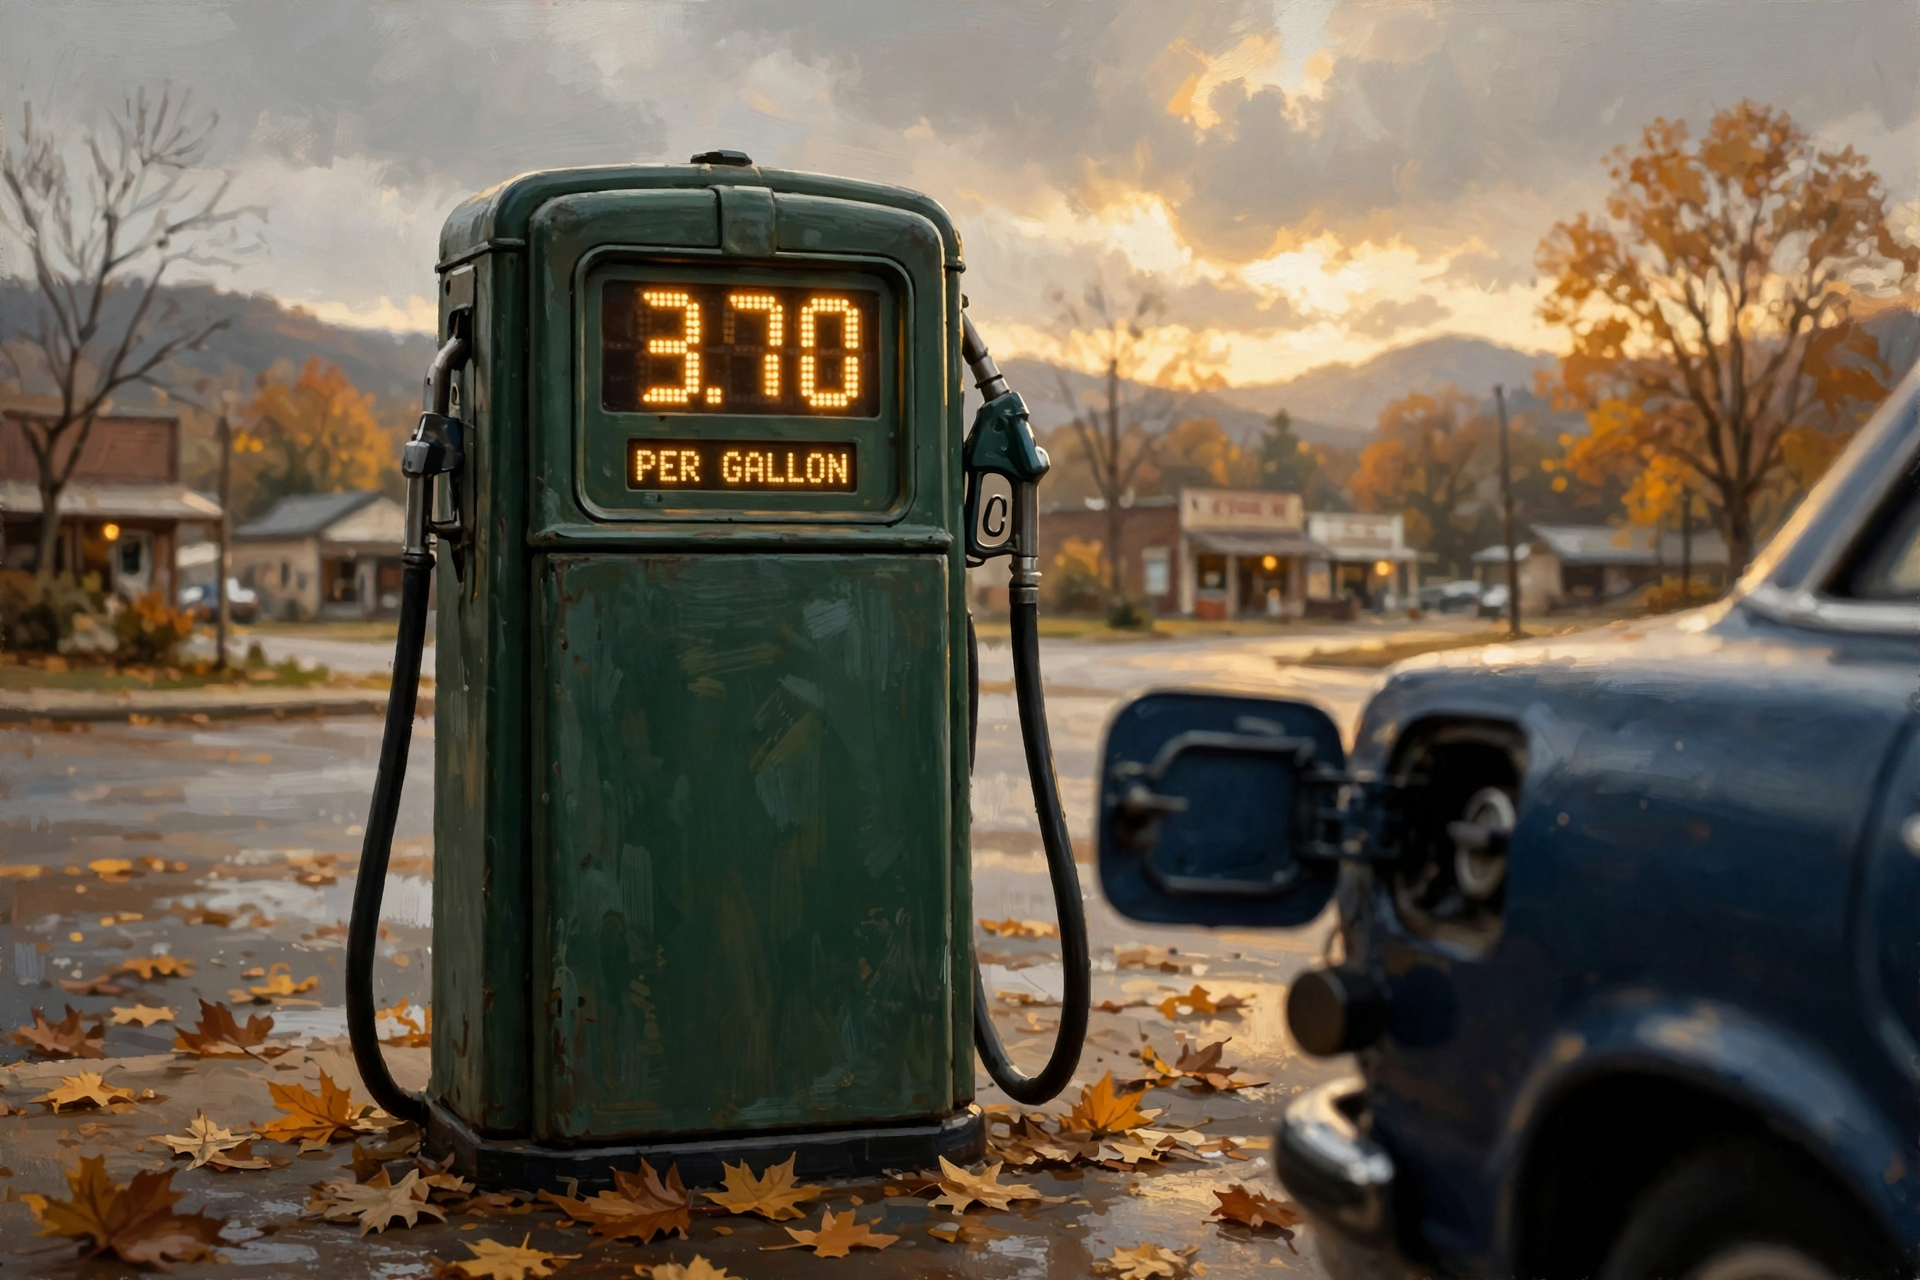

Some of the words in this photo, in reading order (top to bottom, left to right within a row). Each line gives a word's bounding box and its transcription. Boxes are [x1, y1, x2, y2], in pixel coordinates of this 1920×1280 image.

[643, 292, 859, 407] 3.70
[636, 449, 700, 482] PER
[722, 451, 848, 484] GALLON
